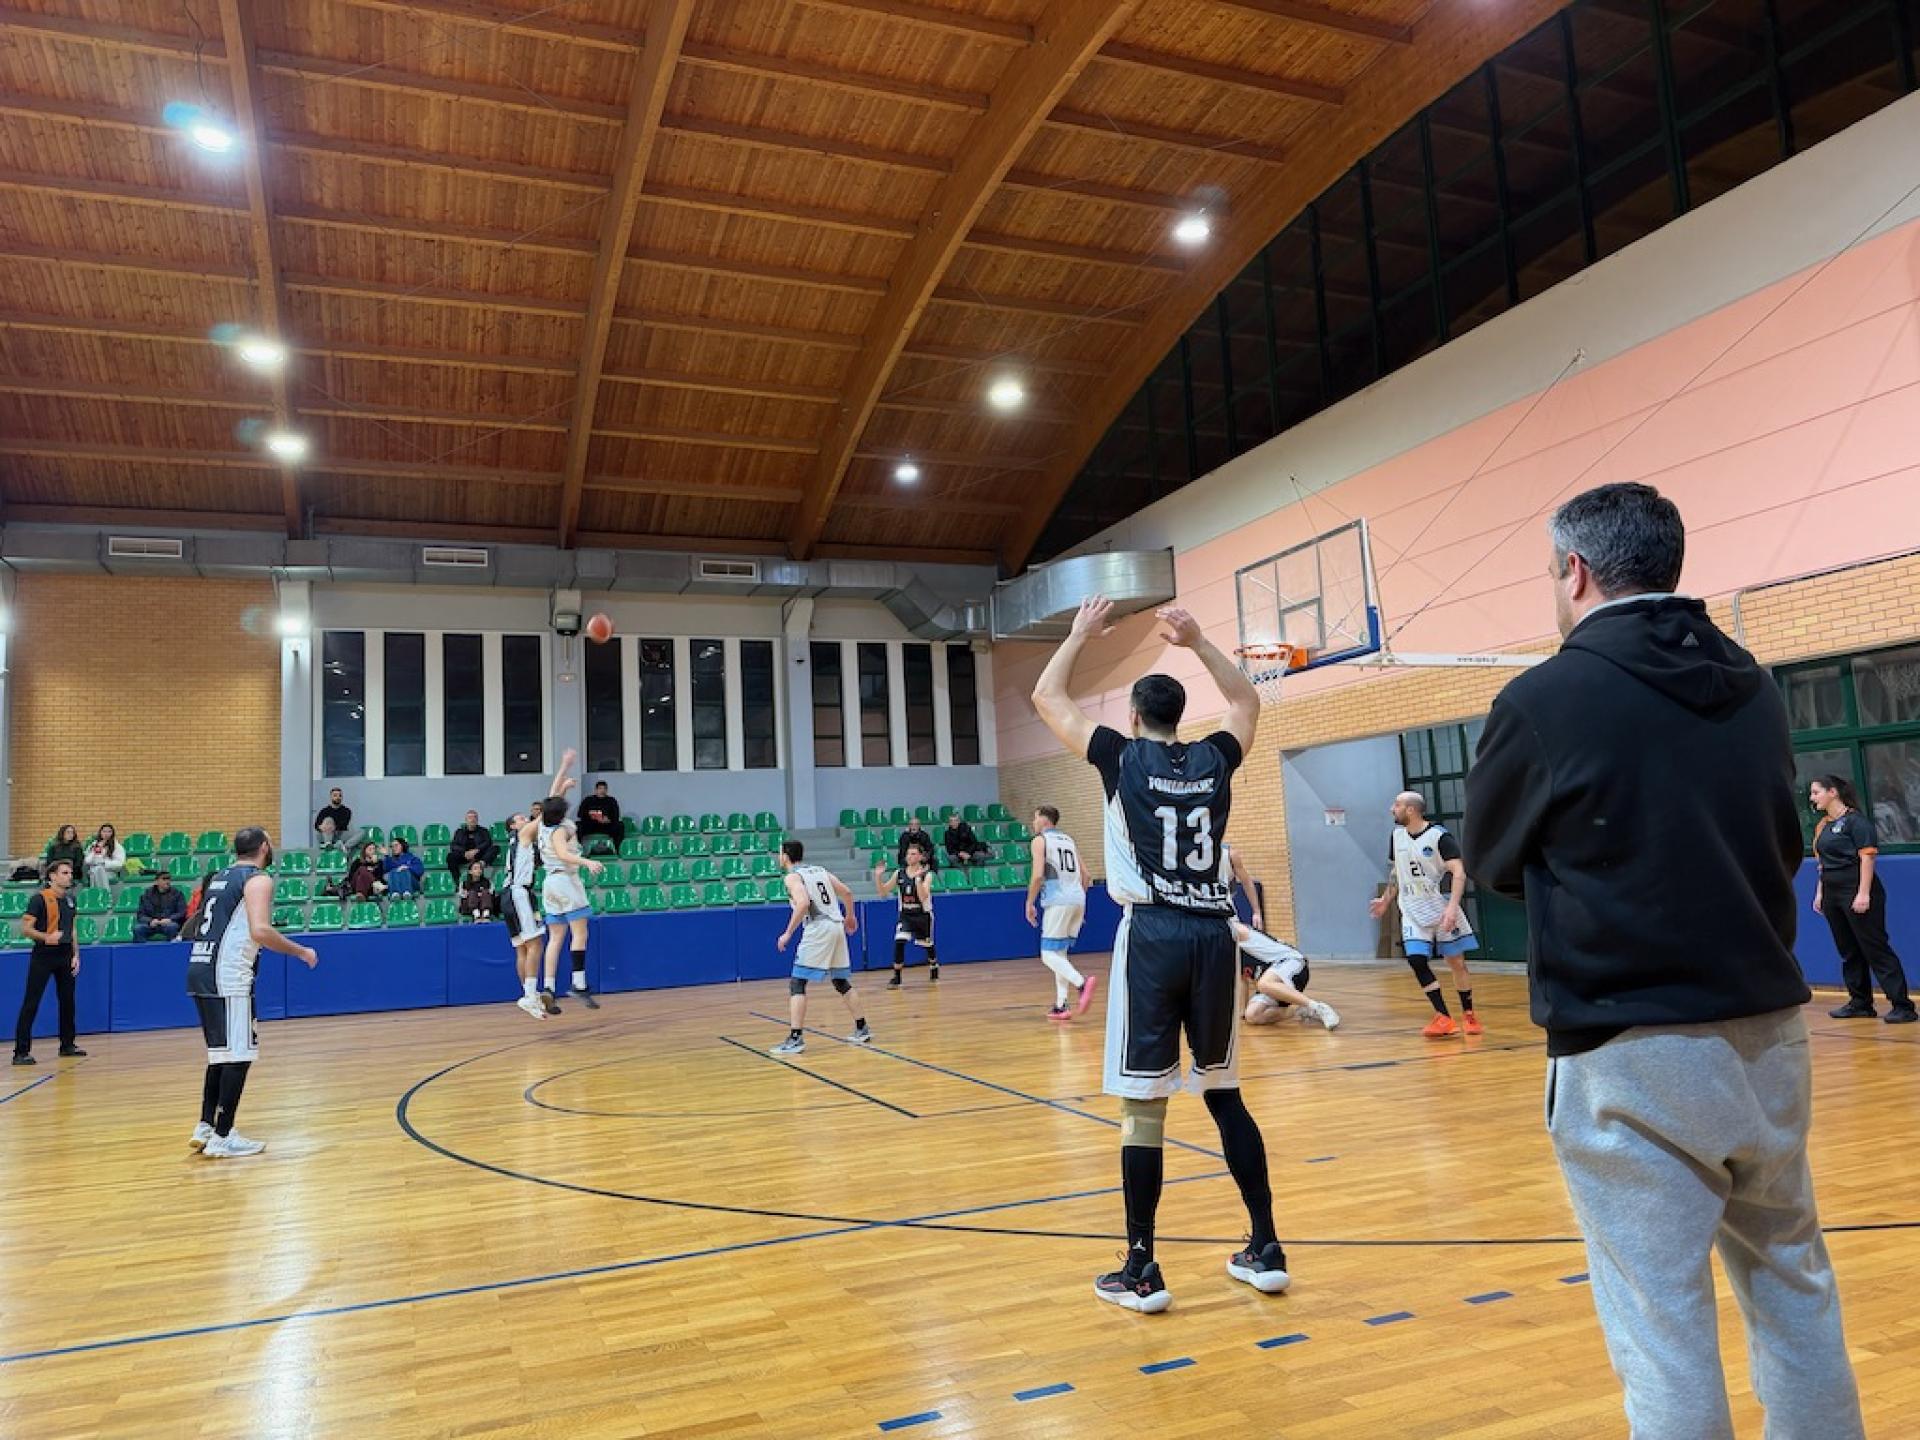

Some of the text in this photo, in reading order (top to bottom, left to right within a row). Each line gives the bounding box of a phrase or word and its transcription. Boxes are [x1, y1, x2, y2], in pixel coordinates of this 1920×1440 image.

[1154, 806, 1214, 871] 13
[1057, 847, 1076, 872] 10
[817, 880, 831, 905] 8
[200, 897, 217, 936] 5
